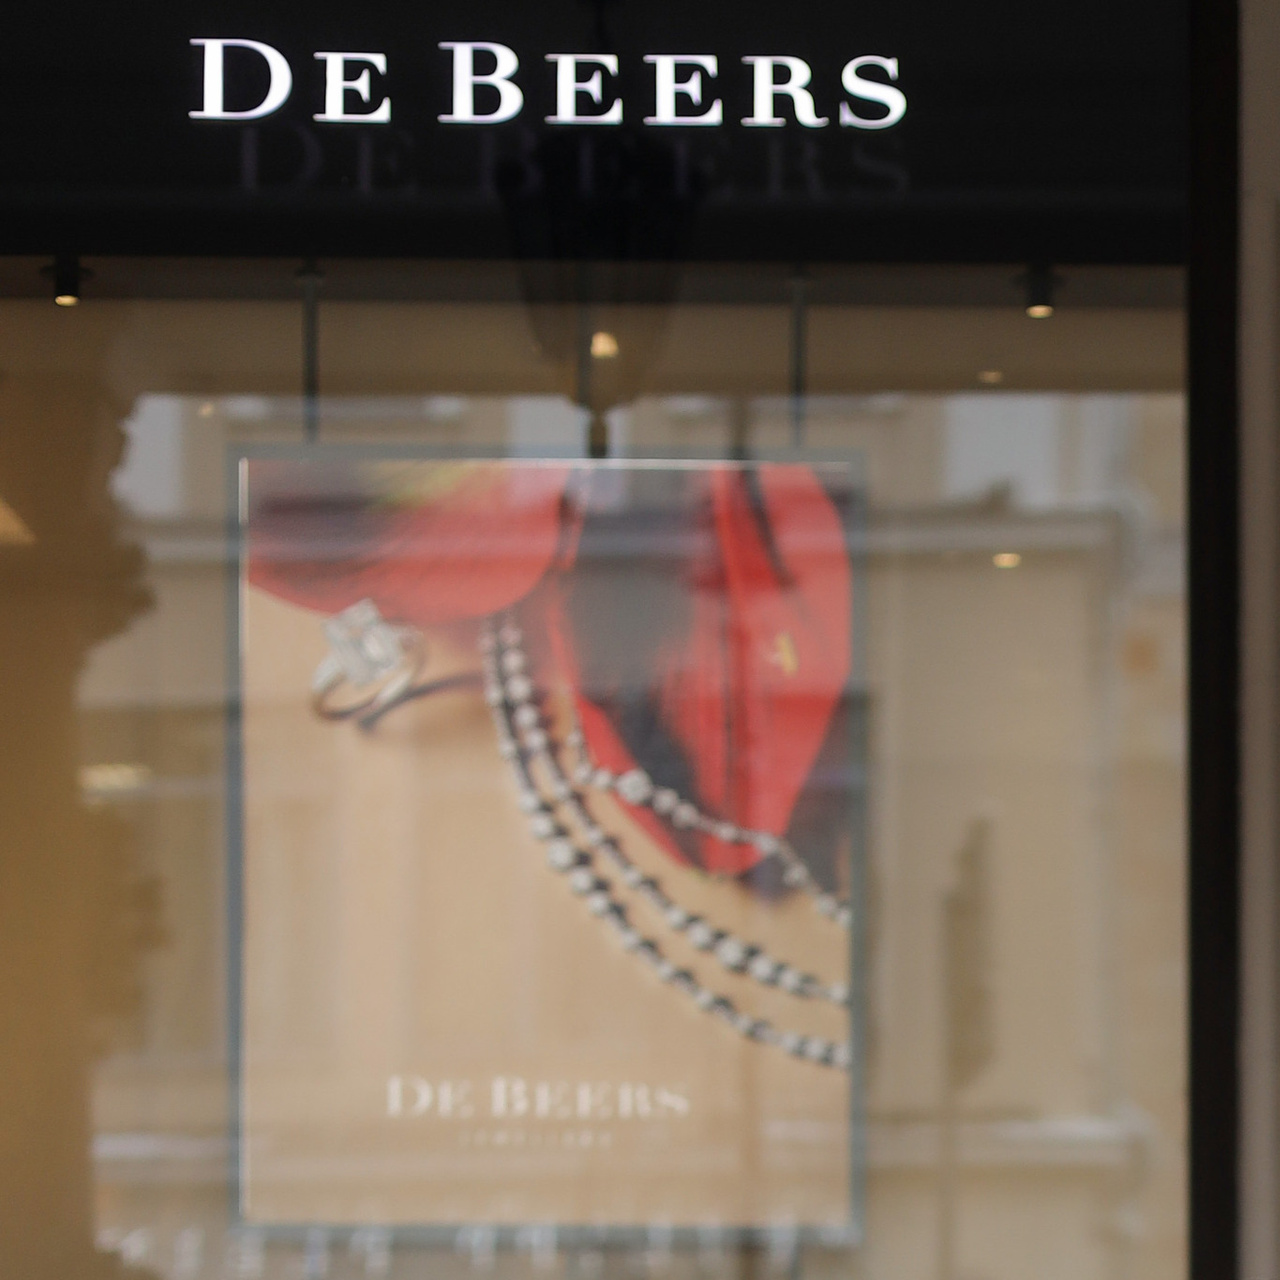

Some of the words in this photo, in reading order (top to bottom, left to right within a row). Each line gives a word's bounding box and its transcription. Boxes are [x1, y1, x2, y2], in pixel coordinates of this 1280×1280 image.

[188, 38, 392, 123] DE
[437, 41, 908, 129] BEERS
[386, 1074, 475, 1119] DE
[490, 1074, 690, 1120] BEERS
